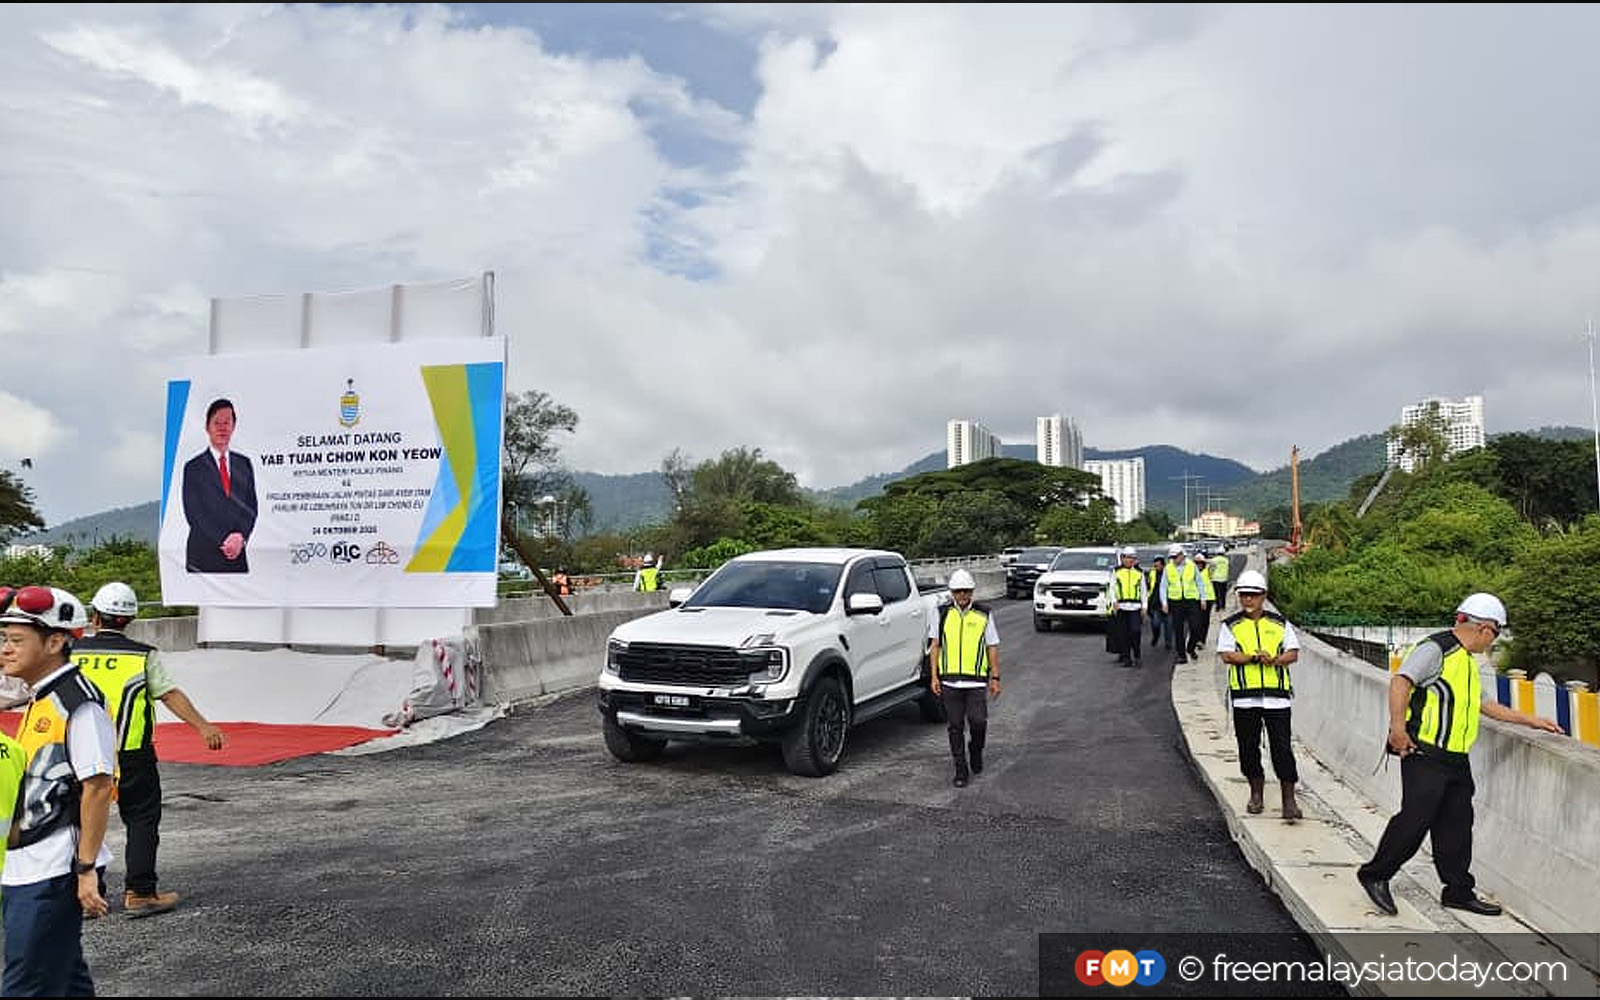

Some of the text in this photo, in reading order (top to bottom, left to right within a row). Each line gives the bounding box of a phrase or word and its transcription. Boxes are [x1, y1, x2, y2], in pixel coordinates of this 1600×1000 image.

[297, 432, 402, 447] SELAMAT DATANG
[260, 447, 442, 466] YAB TUAN CHOW KON YEOW
[318, 467, 349, 476] MENTERI
[323, 526, 358, 535] OKTOBER
[77, 656, 118, 669] PIC
